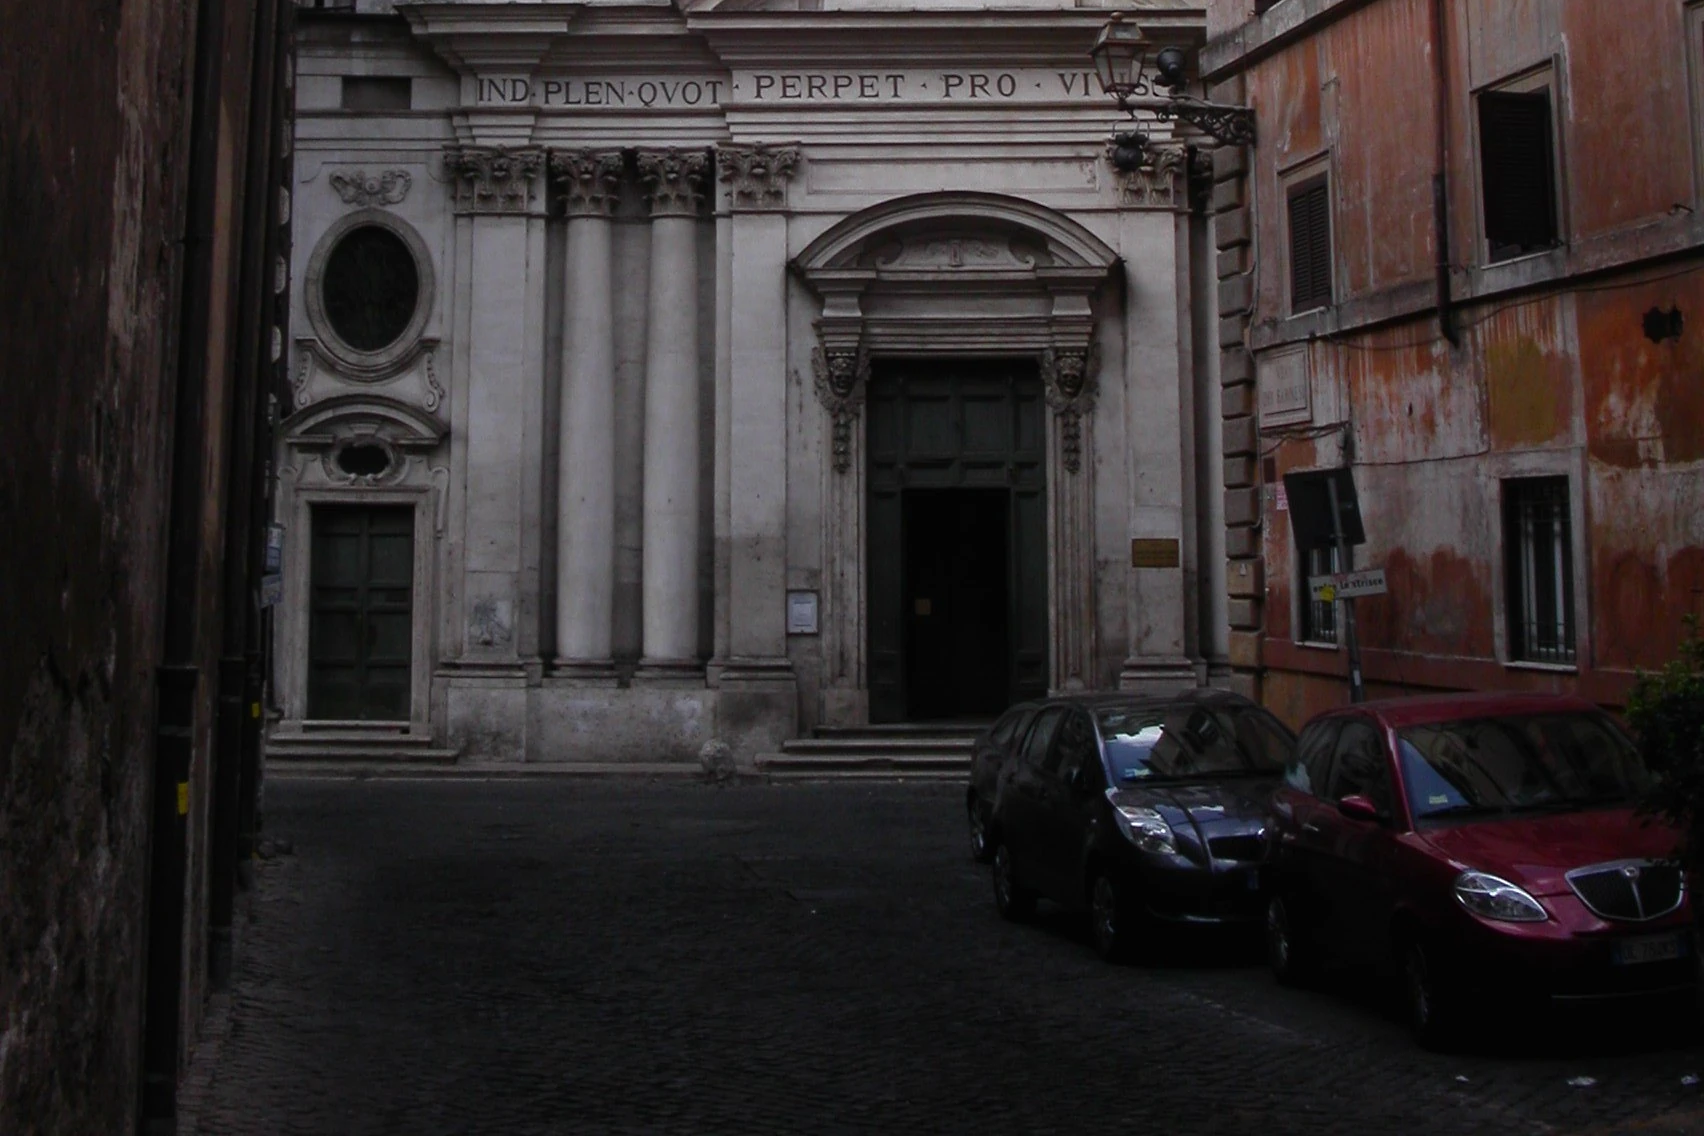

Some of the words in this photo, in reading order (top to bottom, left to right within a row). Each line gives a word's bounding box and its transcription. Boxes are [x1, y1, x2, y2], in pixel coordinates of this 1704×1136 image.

[477, 77, 529, 103] IND
[543, 80, 625, 105] PLEN
[637, 80, 723, 107] QVOT
[753, 74, 905, 99] PERPET
[941, 74, 1016, 98] PRO
